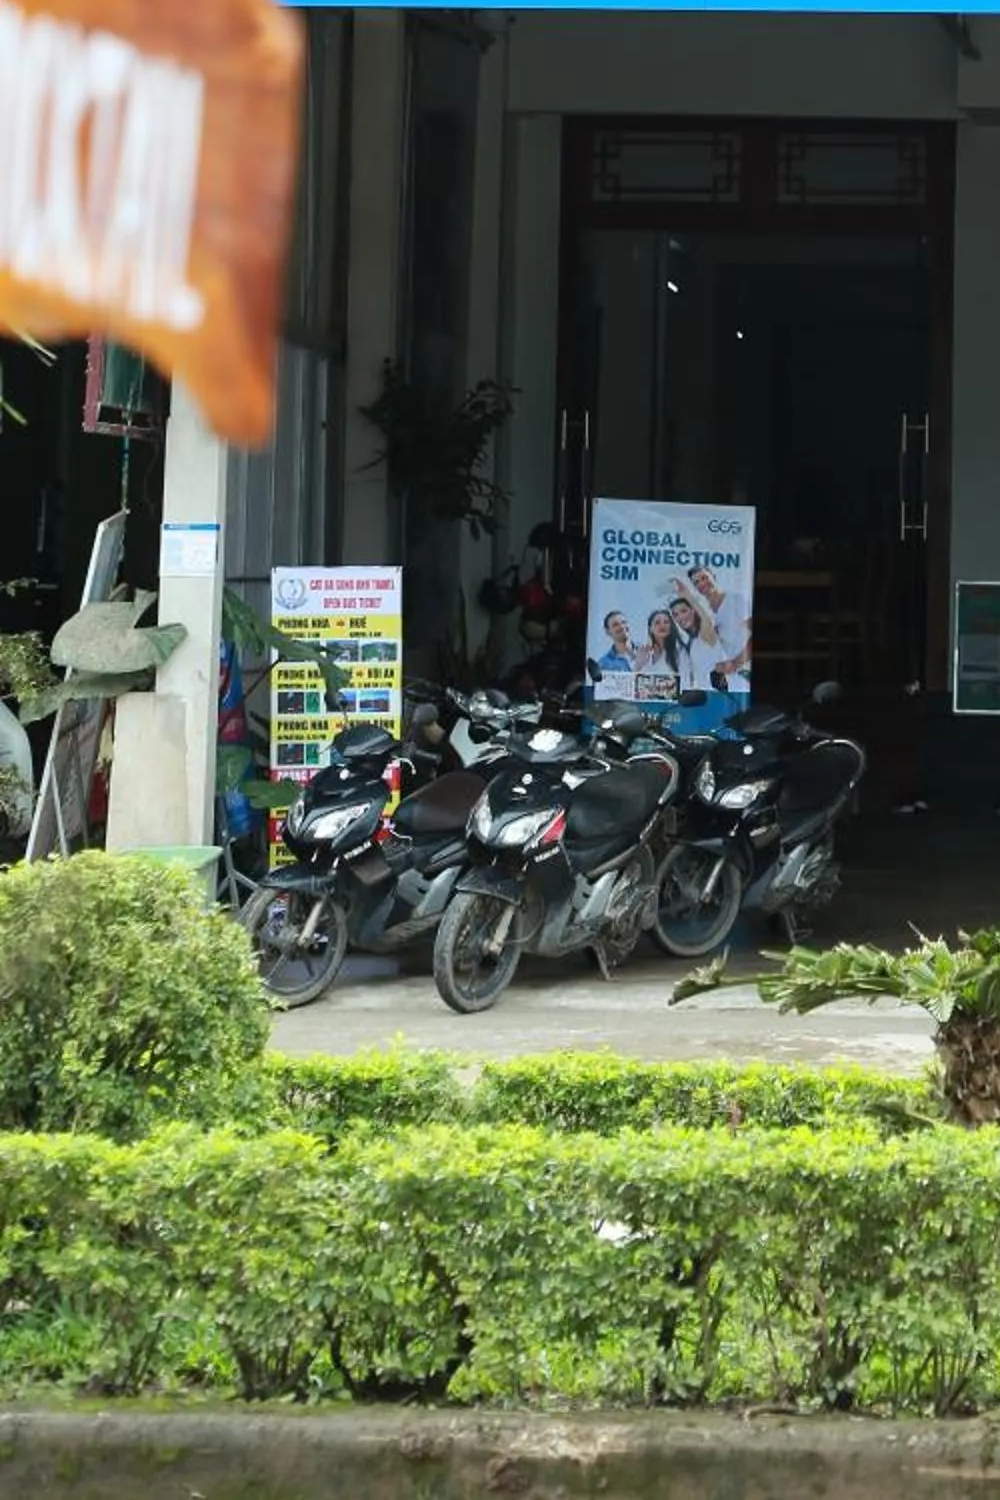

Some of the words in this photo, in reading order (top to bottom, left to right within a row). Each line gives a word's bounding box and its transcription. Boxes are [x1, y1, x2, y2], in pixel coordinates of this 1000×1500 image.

[602, 529, 686, 548] GLOBAL
[601, 547, 740, 568] CONNECTION
[600, 565, 639, 581] SIM
